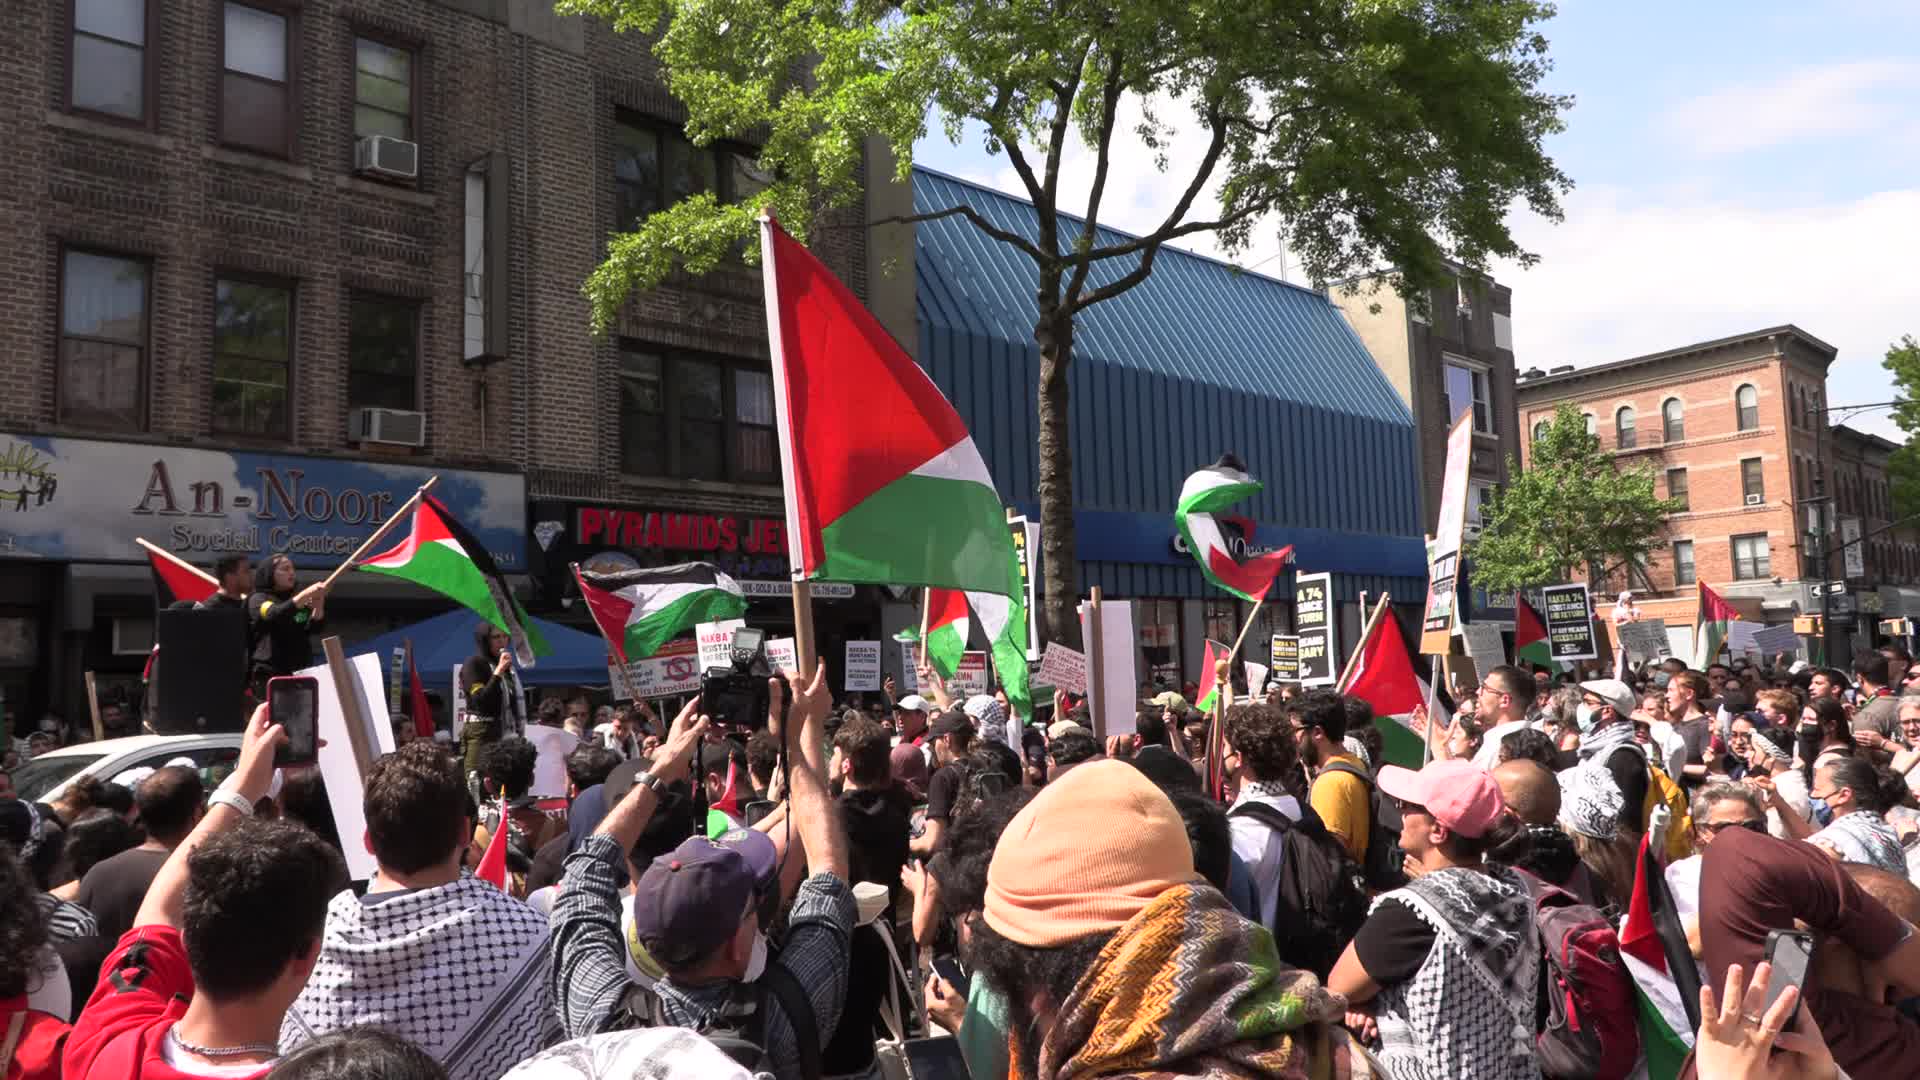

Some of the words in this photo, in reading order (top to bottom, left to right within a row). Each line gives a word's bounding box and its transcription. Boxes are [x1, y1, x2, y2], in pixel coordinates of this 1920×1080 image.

[132, 459, 393, 524] An-Noor
[171, 524, 260, 553] Social
[269, 526, 361, 556] Center
[578, 508, 738, 550] PYRAMIDS
[1306, 587, 1324, 601] 74
[700, 632, 728, 644] NAKBA
[653, 682, 700, 694] Atrocities
